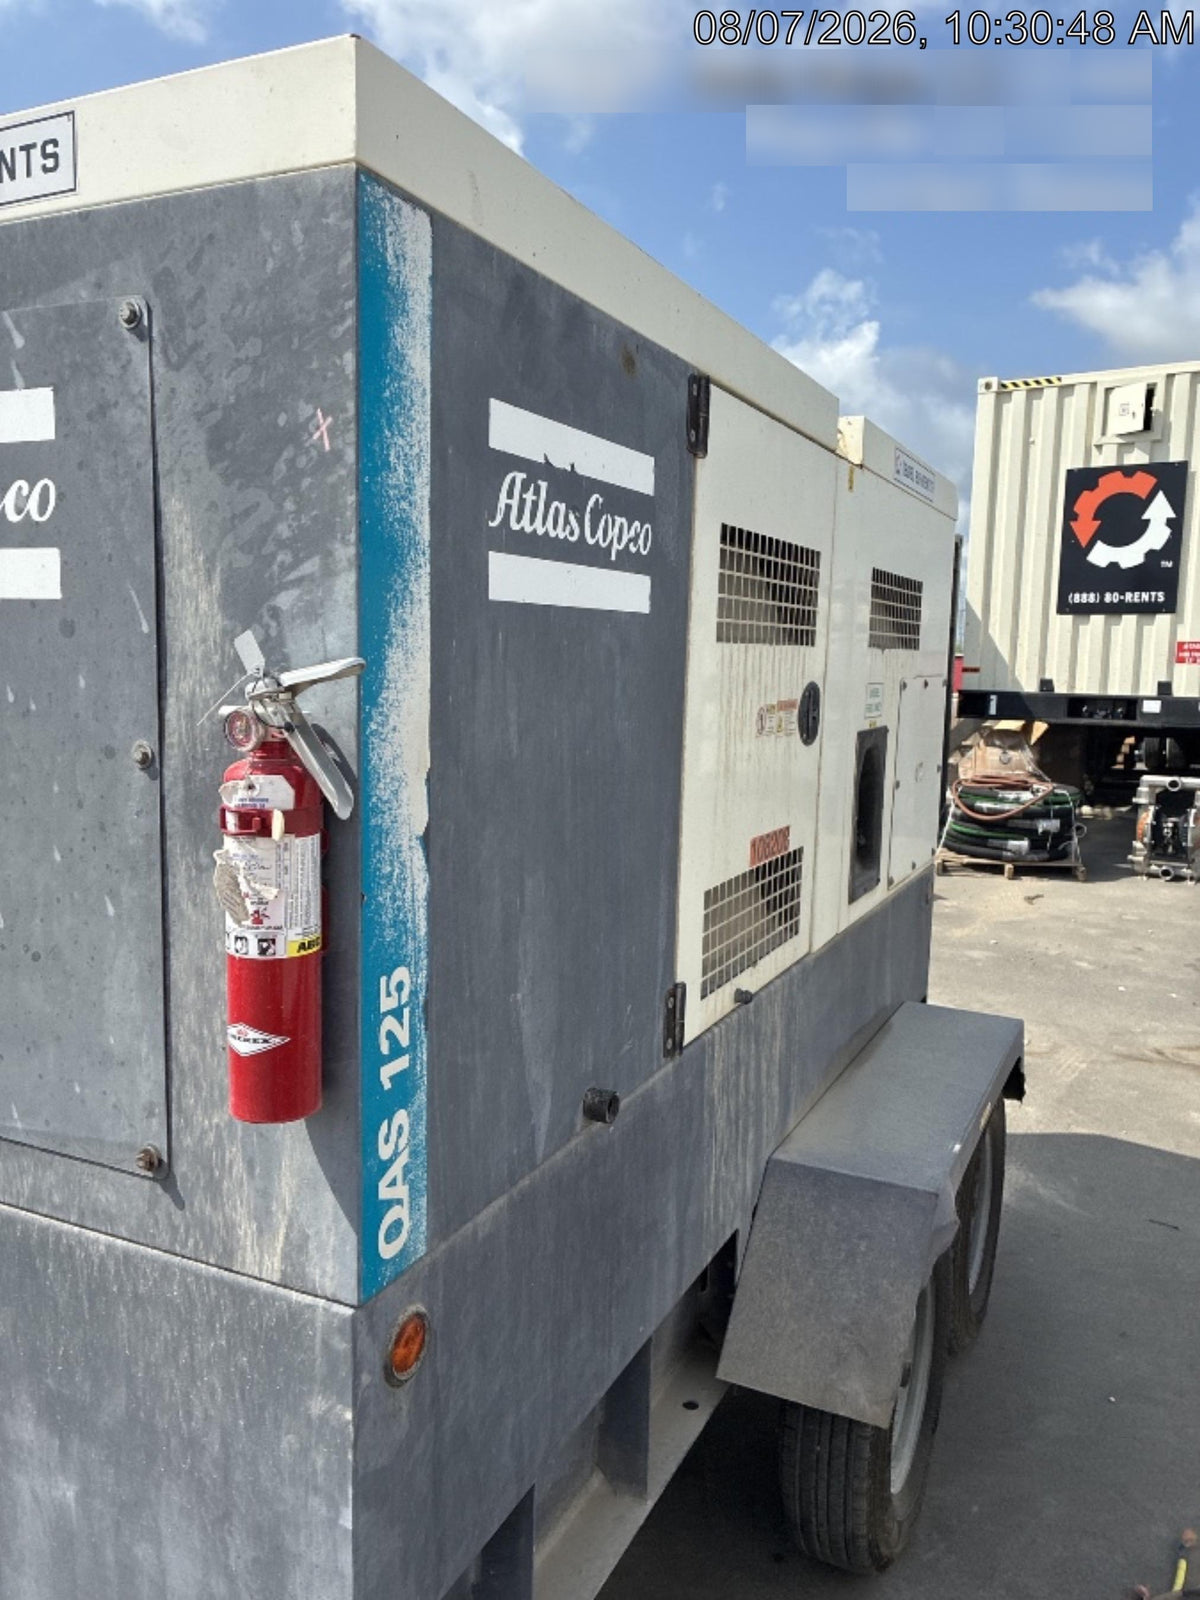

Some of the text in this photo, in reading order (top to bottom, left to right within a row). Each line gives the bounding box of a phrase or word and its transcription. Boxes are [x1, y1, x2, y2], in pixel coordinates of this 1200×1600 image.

[488, 471, 652, 561] Atlas Copco
[1068, 591, 1166, 604] (888) 80-RENTS
[378, 966, 411, 1259] QAS 125
